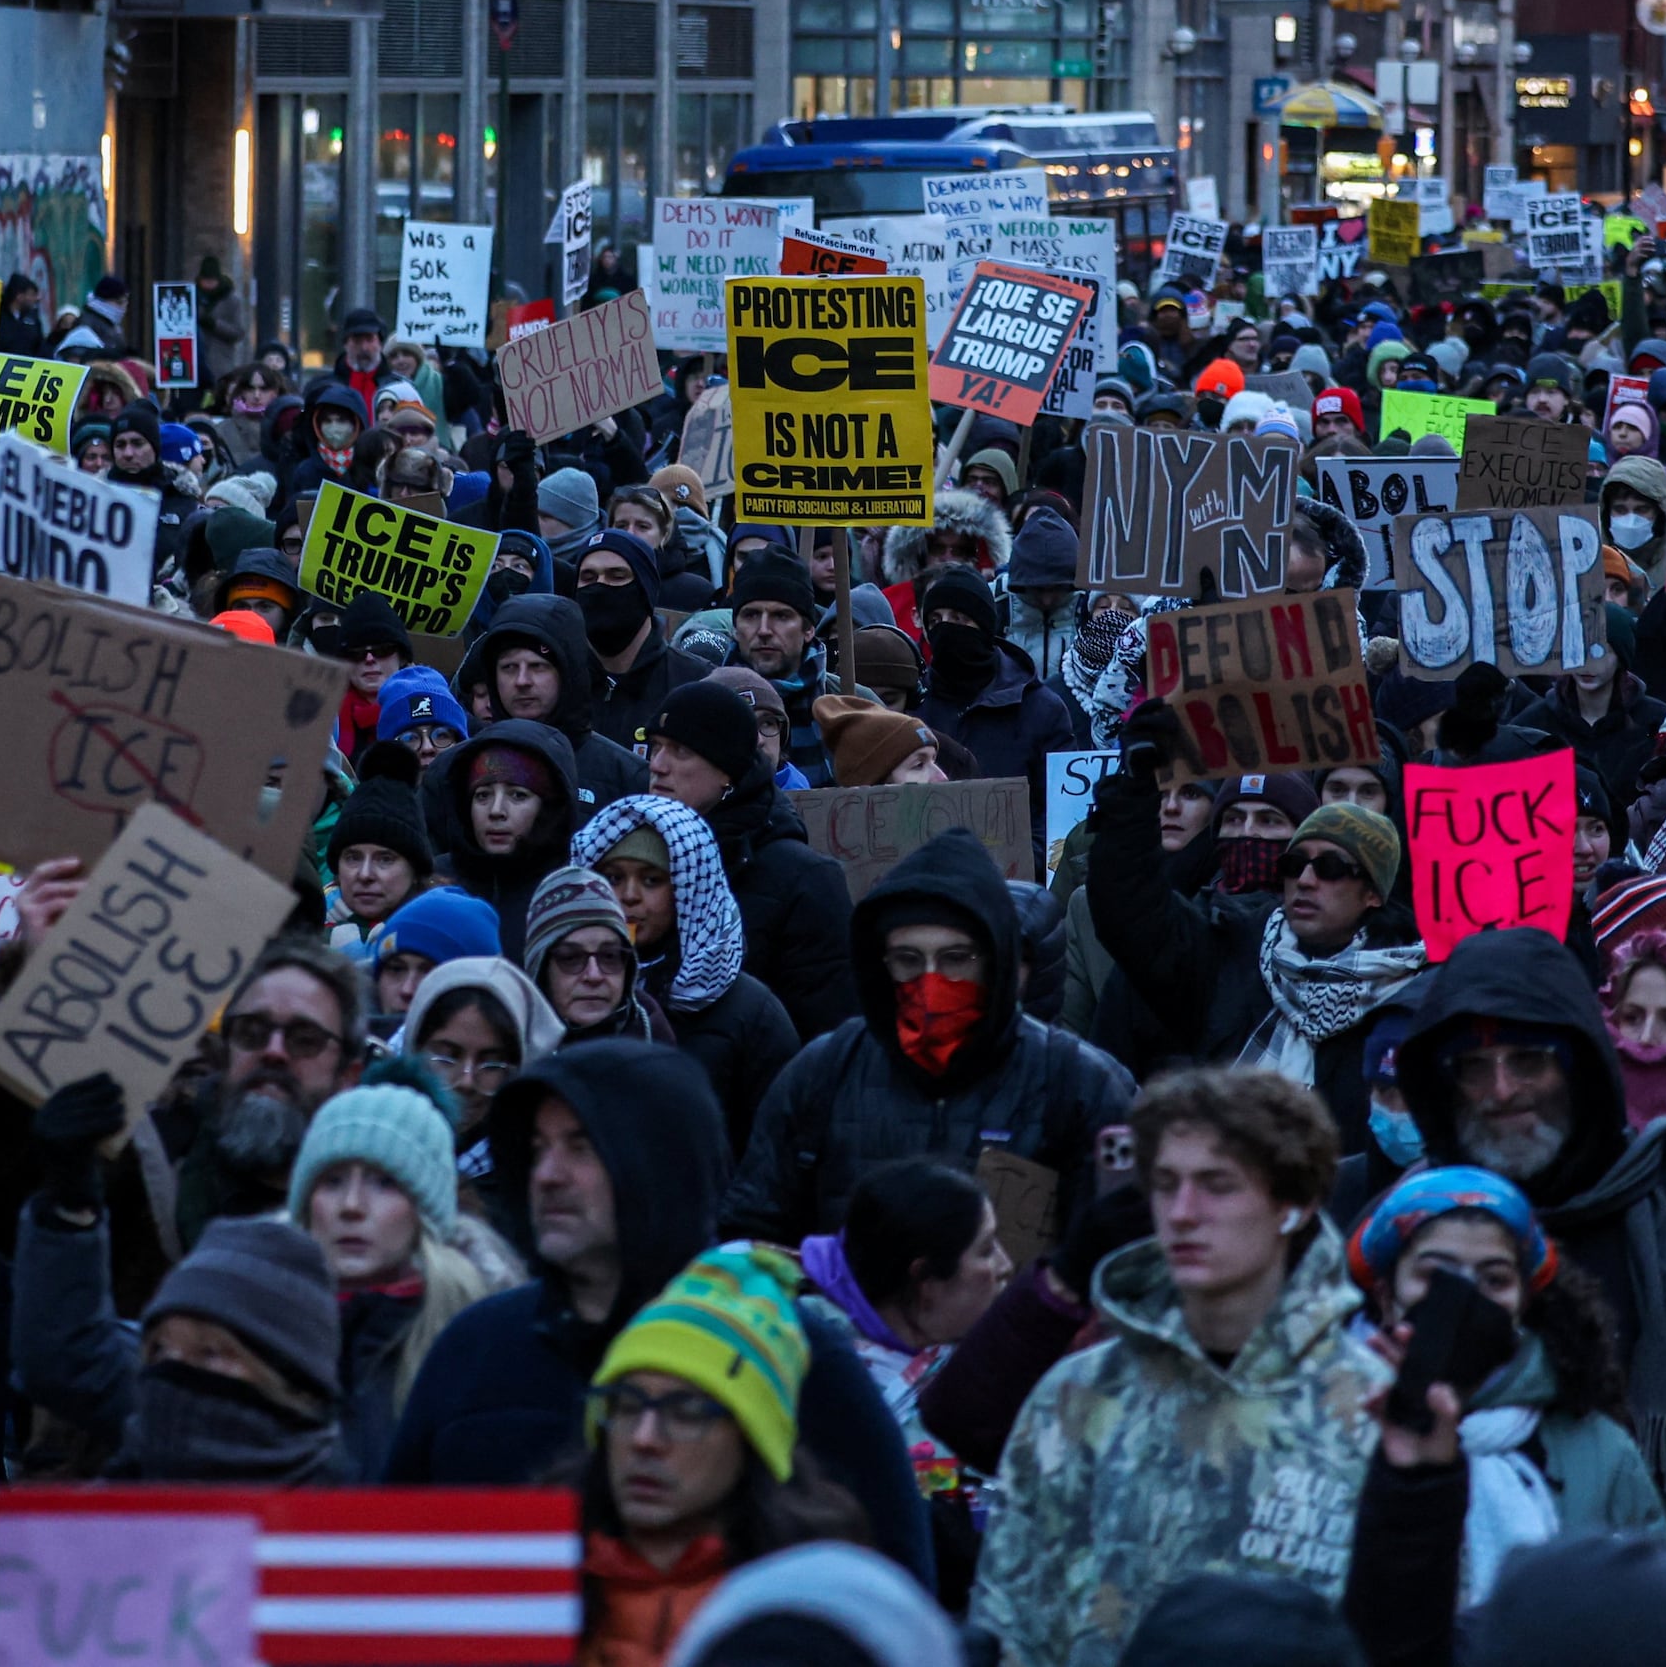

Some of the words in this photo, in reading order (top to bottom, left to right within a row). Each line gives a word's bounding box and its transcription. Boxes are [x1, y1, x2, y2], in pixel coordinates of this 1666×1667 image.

[927, 176, 1028, 199] DEMOCRATS
[662, 202, 717, 225] DEMS
[724, 205, 776, 228] WONT
[1529, 211, 1580, 230] ICE
[686, 230, 710, 250] DO
[717, 229, 736, 249] IT
[794, 227, 876, 258] RefuseFascism.org
[1010, 238, 1064, 257] MASS
[1171, 232, 1221, 252] ICE
[409, 258, 450, 281] 50K
[657, 255, 677, 275] WE
[685, 254, 727, 275] NEED
[734, 256, 770, 276] MASS
[1318, 251, 1361, 281] NY
[732, 285, 917, 331] PROTESTING
[971, 279, 1034, 316] ¡QUE
[1036, 291, 1078, 326] SE
[500, 306, 610, 390] CRUELTY
[612, 290, 649, 347] IS
[956, 306, 1064, 355] LARGUE
[735, 335, 916, 393] ICE
[947, 335, 1047, 382] TRUMP
[33, 370, 65, 404] is
[508, 376, 565, 438] NOT
[568, 341, 662, 424] NORMAL
[957, 372, 1012, 409] YA!
[1429, 399, 1469, 419] ICE
[764, 411, 797, 458] IS
[801, 412, 870, 460] NOT
[876, 412, 900, 459] A
[1491, 420, 1562, 454] ICE
[741, 462, 924, 492] CRIME!
[1462, 449, 1584, 491] EXECUTES
[745, 496, 777, 514] PARTY
[777, 497, 796, 514] FOR
[797, 497, 850, 515] SOCIALISM
[851, 501, 864, 515] &
[865, 498, 923, 516] LIBERATION
[1088, 428, 1217, 589] NY
[1188, 489, 1226, 528] with
[1486, 482, 1566, 509] WOMEN
[331, 491, 440, 562] ICE
[440, 532, 476, 573] is
[322, 534, 467, 609] TRUMP'S
[1398, 511, 1606, 671] STOP.
[1149, 595, 1352, 698] DEFUND
[53, 714, 197, 806] ICE
[1410, 781, 1564, 853] FUCK
[3, 837, 208, 1088] ABOLISH
[106, 936, 241, 1069] ICE
